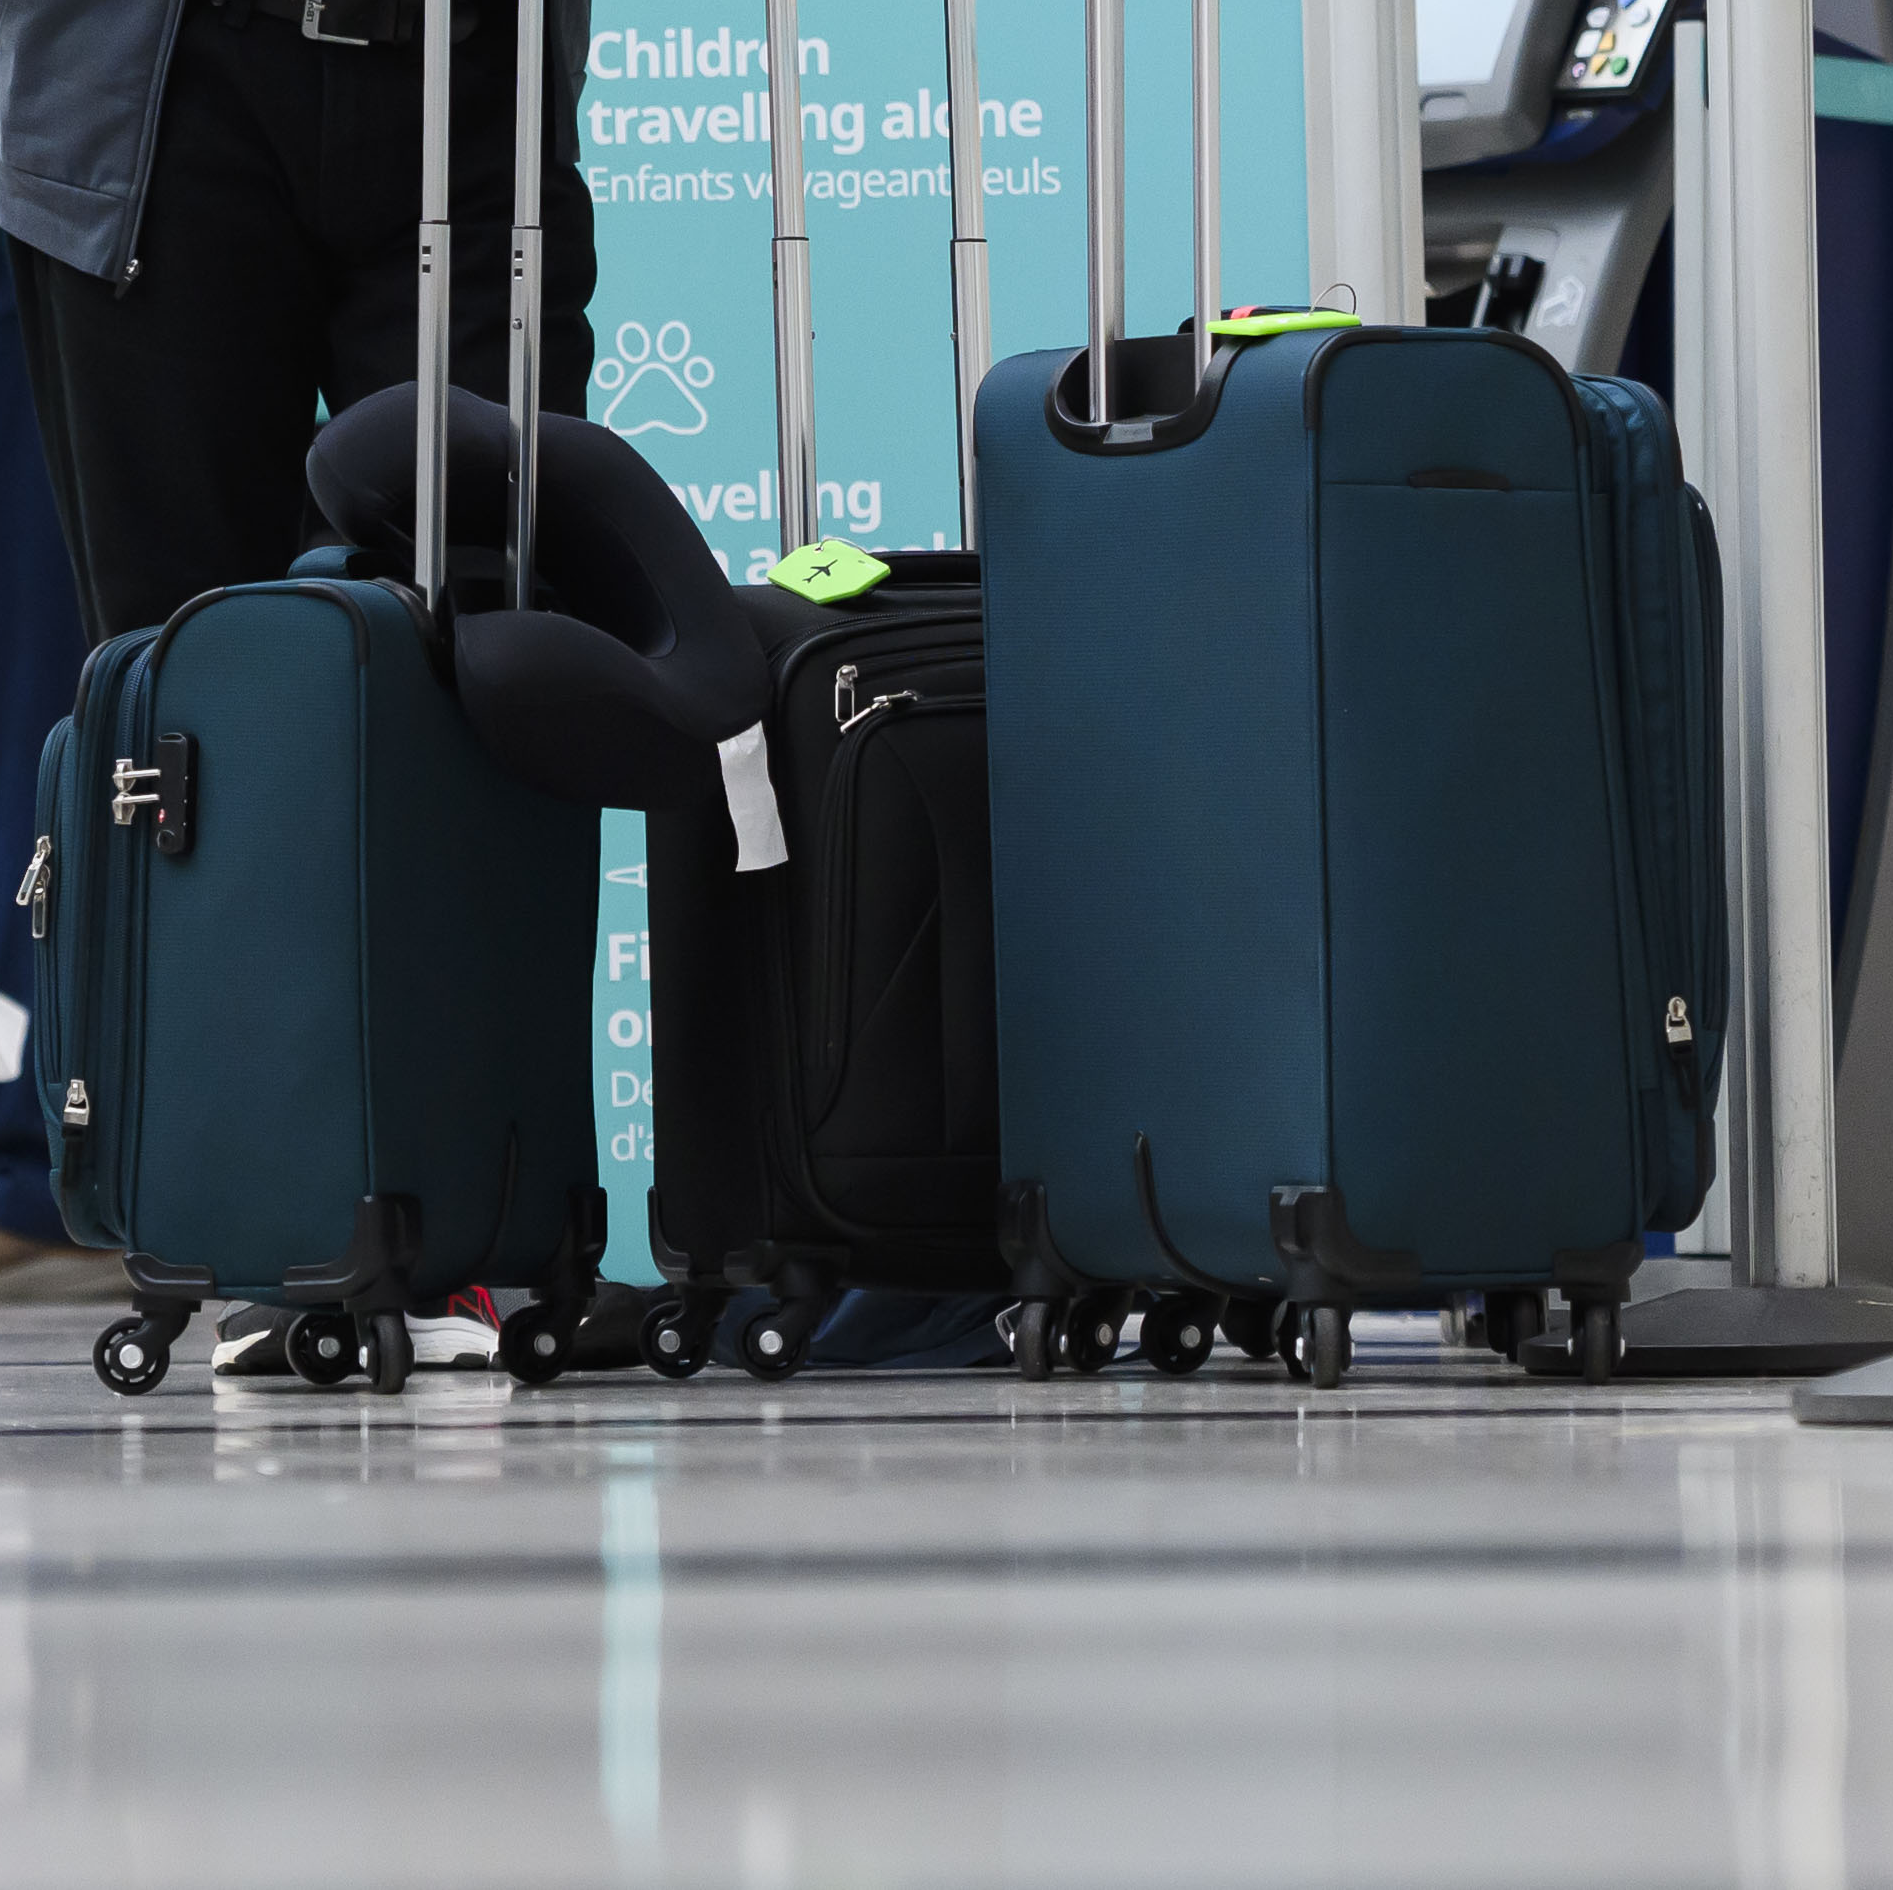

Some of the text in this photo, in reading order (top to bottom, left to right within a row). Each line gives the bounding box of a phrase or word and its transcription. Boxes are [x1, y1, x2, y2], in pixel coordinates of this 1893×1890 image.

[586, 25, 831, 81] Childrn
[586, 90, 866, 156] travellng
[586, 156, 1062, 210] Enfants vageant euls
